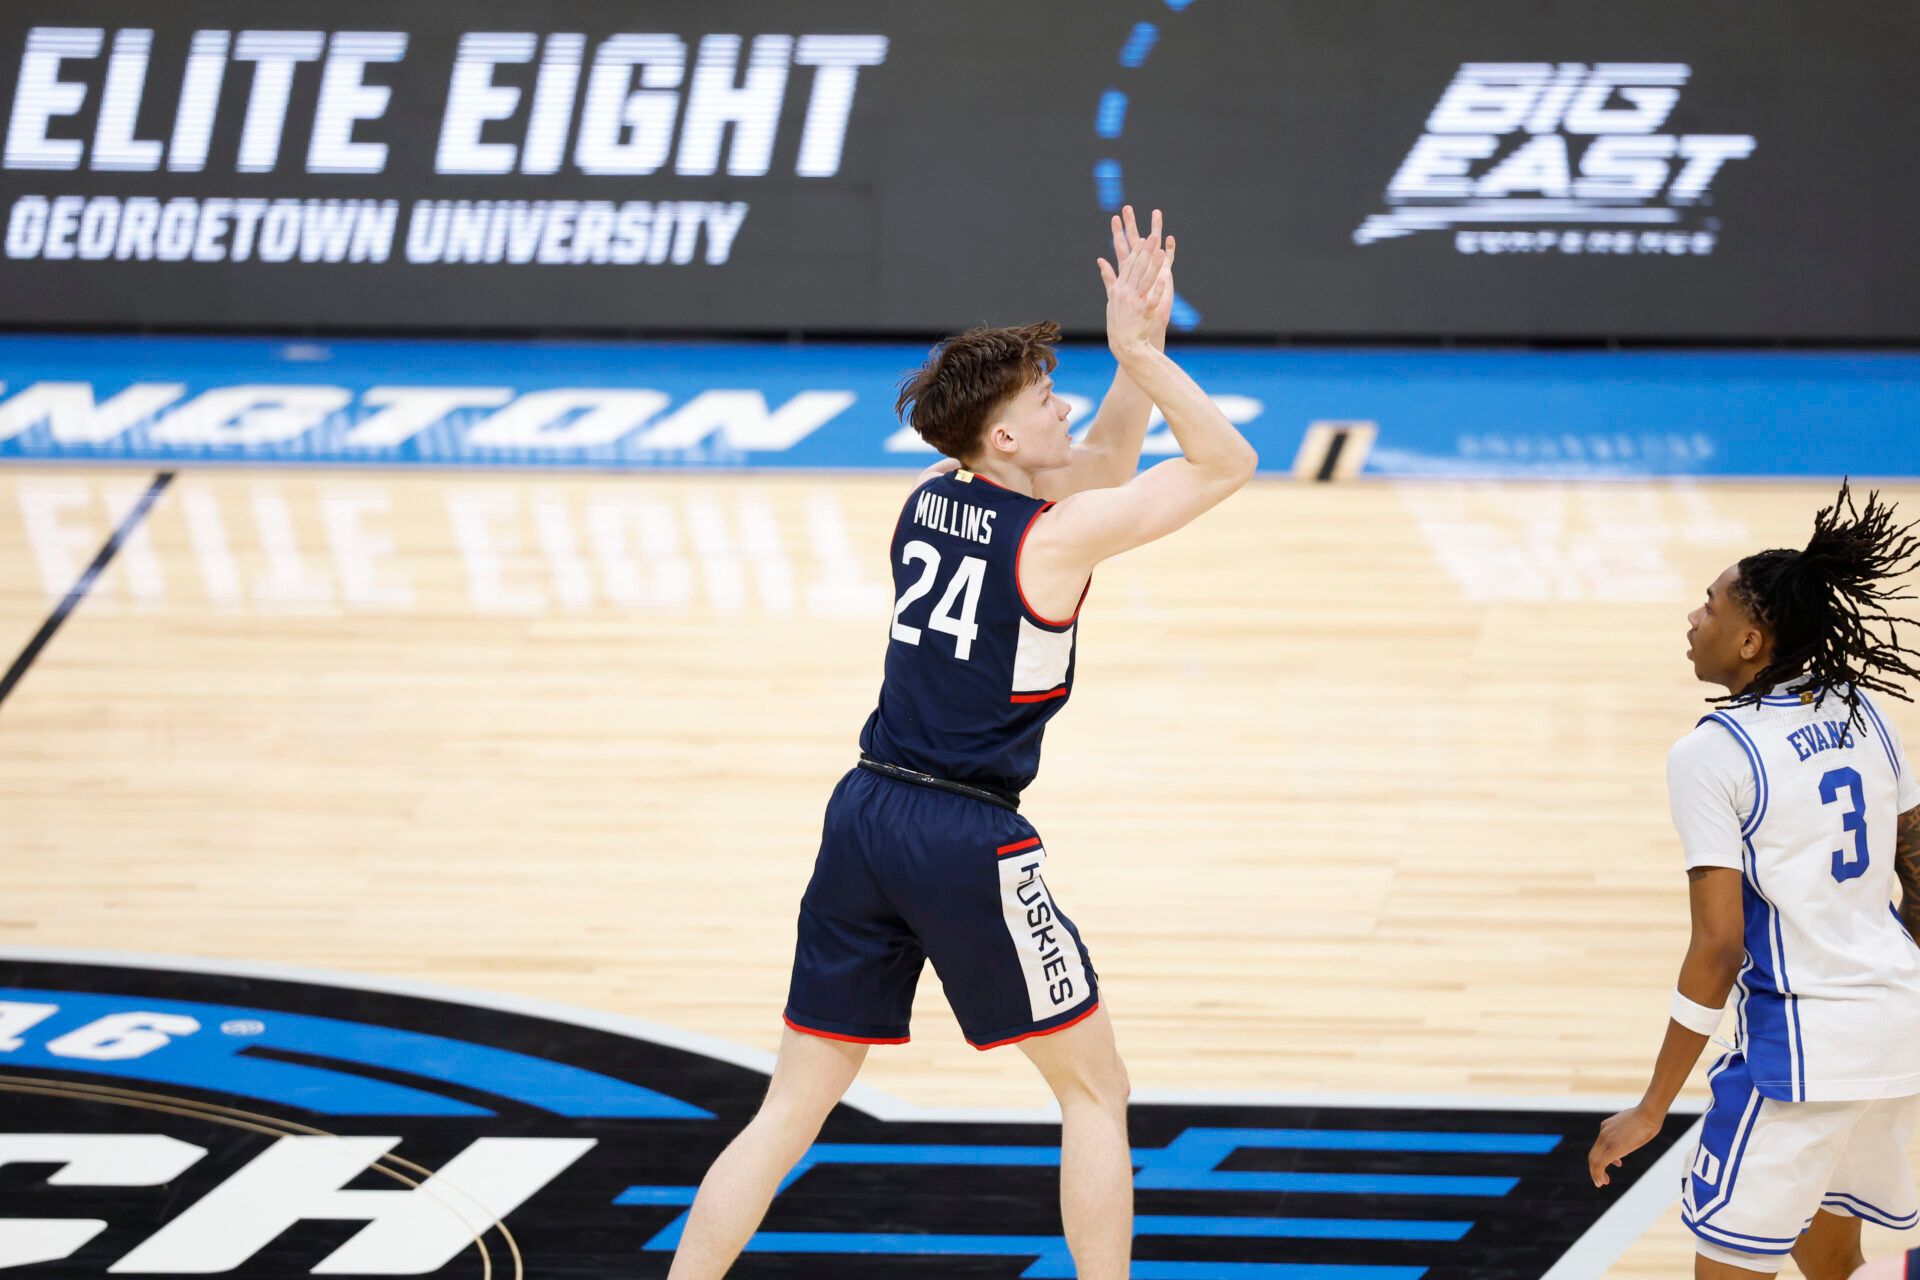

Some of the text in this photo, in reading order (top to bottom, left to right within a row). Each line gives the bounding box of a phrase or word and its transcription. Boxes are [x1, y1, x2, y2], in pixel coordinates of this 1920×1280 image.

[3, 27, 889, 177] ELITE EIGHT
[1425, 62, 1693, 134] BIG
[1385, 134, 1757, 205] EAST
[5, 196, 748, 265] GEORGETOWN UNIVERSITY
[0, 381, 857, 451] NGTON
[913, 490, 997, 545] MULLINS
[891, 540, 988, 661] 24
[1786, 720, 1855, 762] EVANS
[1818, 766, 1871, 883] 3
[1016, 862, 1074, 1006] HUSKIES
